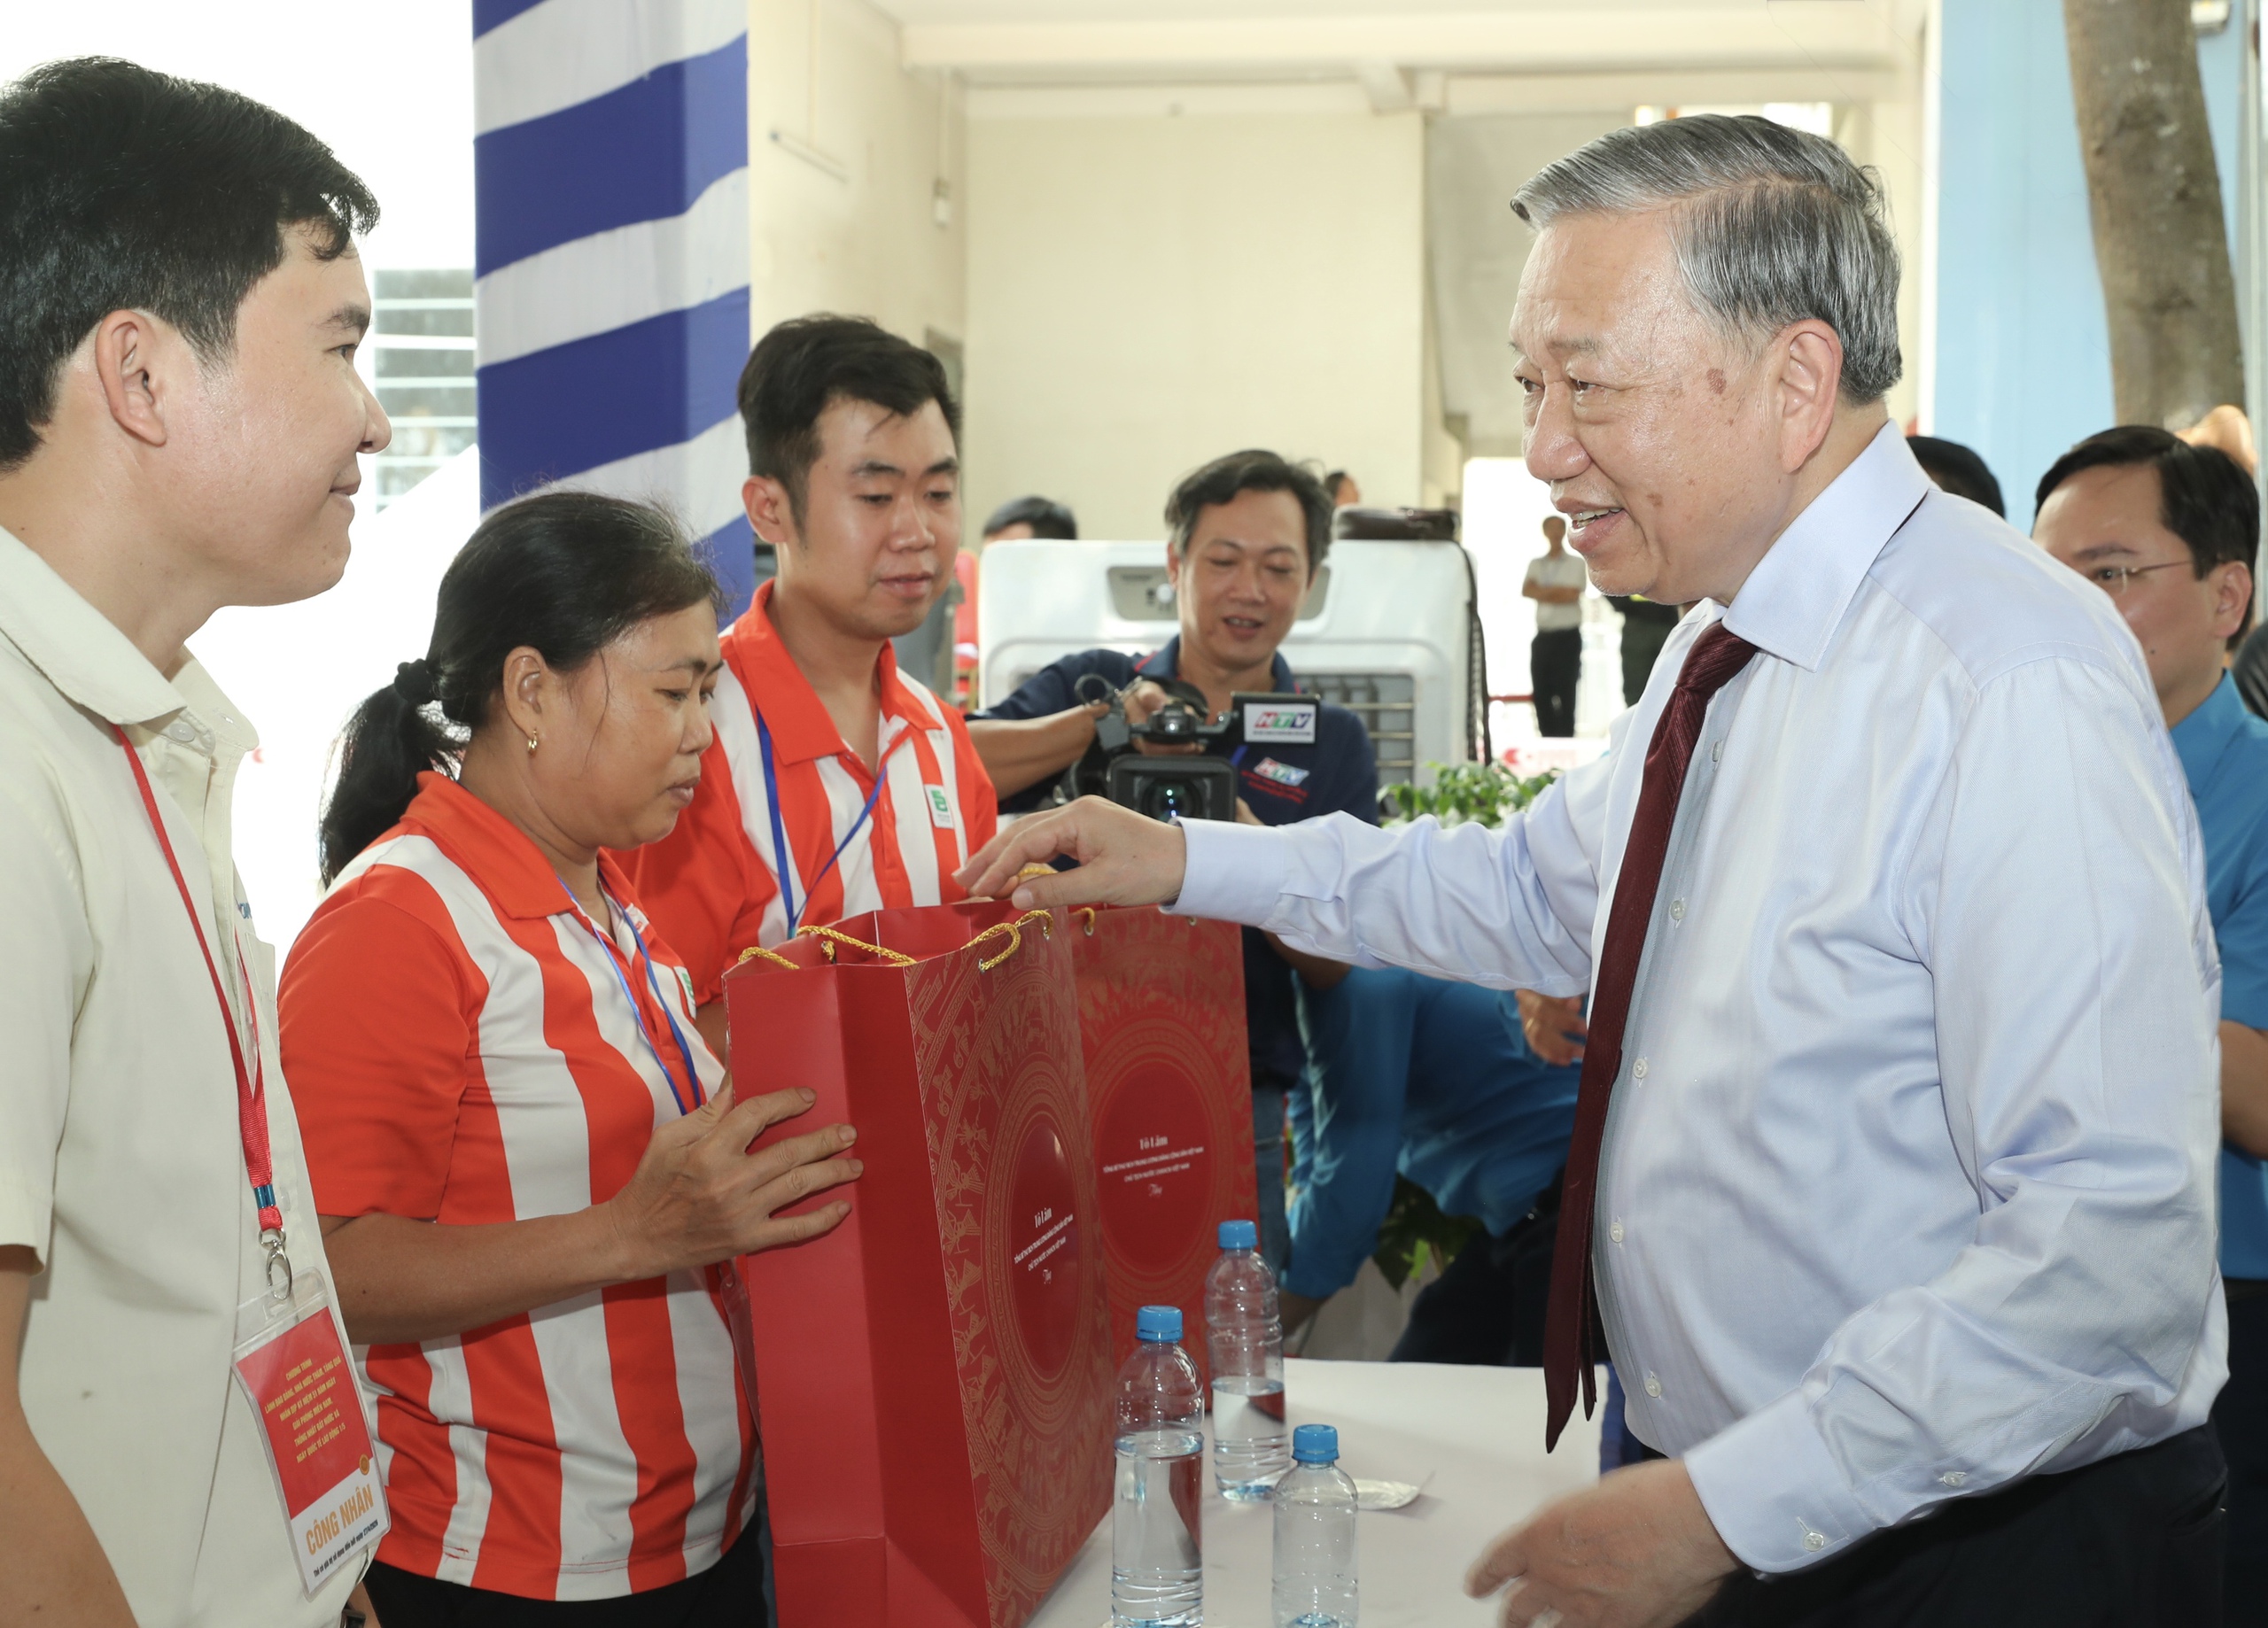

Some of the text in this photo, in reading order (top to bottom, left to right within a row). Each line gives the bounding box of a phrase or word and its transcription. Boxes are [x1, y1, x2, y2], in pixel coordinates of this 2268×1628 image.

[1254, 712, 1311, 728] HTV
[1254, 758, 1308, 786] HTV
[307, 1485, 374, 1555] CÔNG NHÂN
